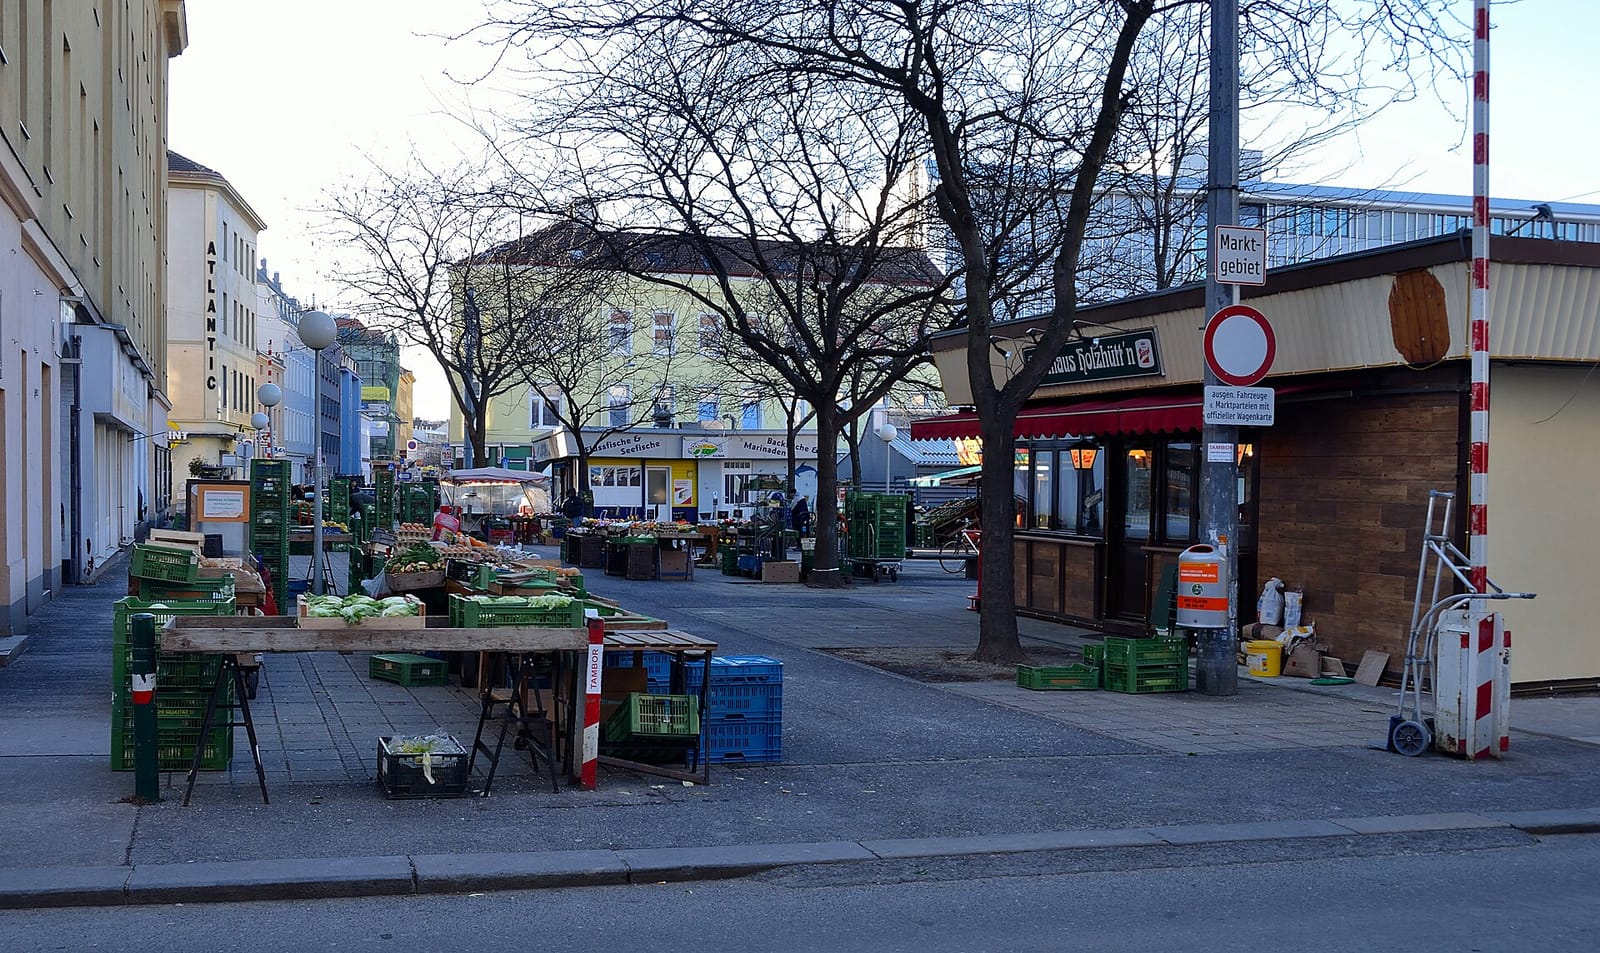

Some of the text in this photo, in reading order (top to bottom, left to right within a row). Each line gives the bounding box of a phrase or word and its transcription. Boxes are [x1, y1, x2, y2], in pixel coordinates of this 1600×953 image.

[1220, 234, 1261, 252] Markt-
[1220, 258, 1261, 276] gebiet
[207, 241, 216, 390] ATLANTIC
[1236, 391, 1268, 401] Fahrzeuge
[1215, 401, 1258, 411] Marktparteien
[1259, 402, 1270, 410] mit
[1206, 411, 1273, 421] offizieller Wagenkarte
[620, 441, 660, 455] Seefische
[743, 441, 787, 456] Marinaden
[590, 648, 599, 689] TAMBOR
